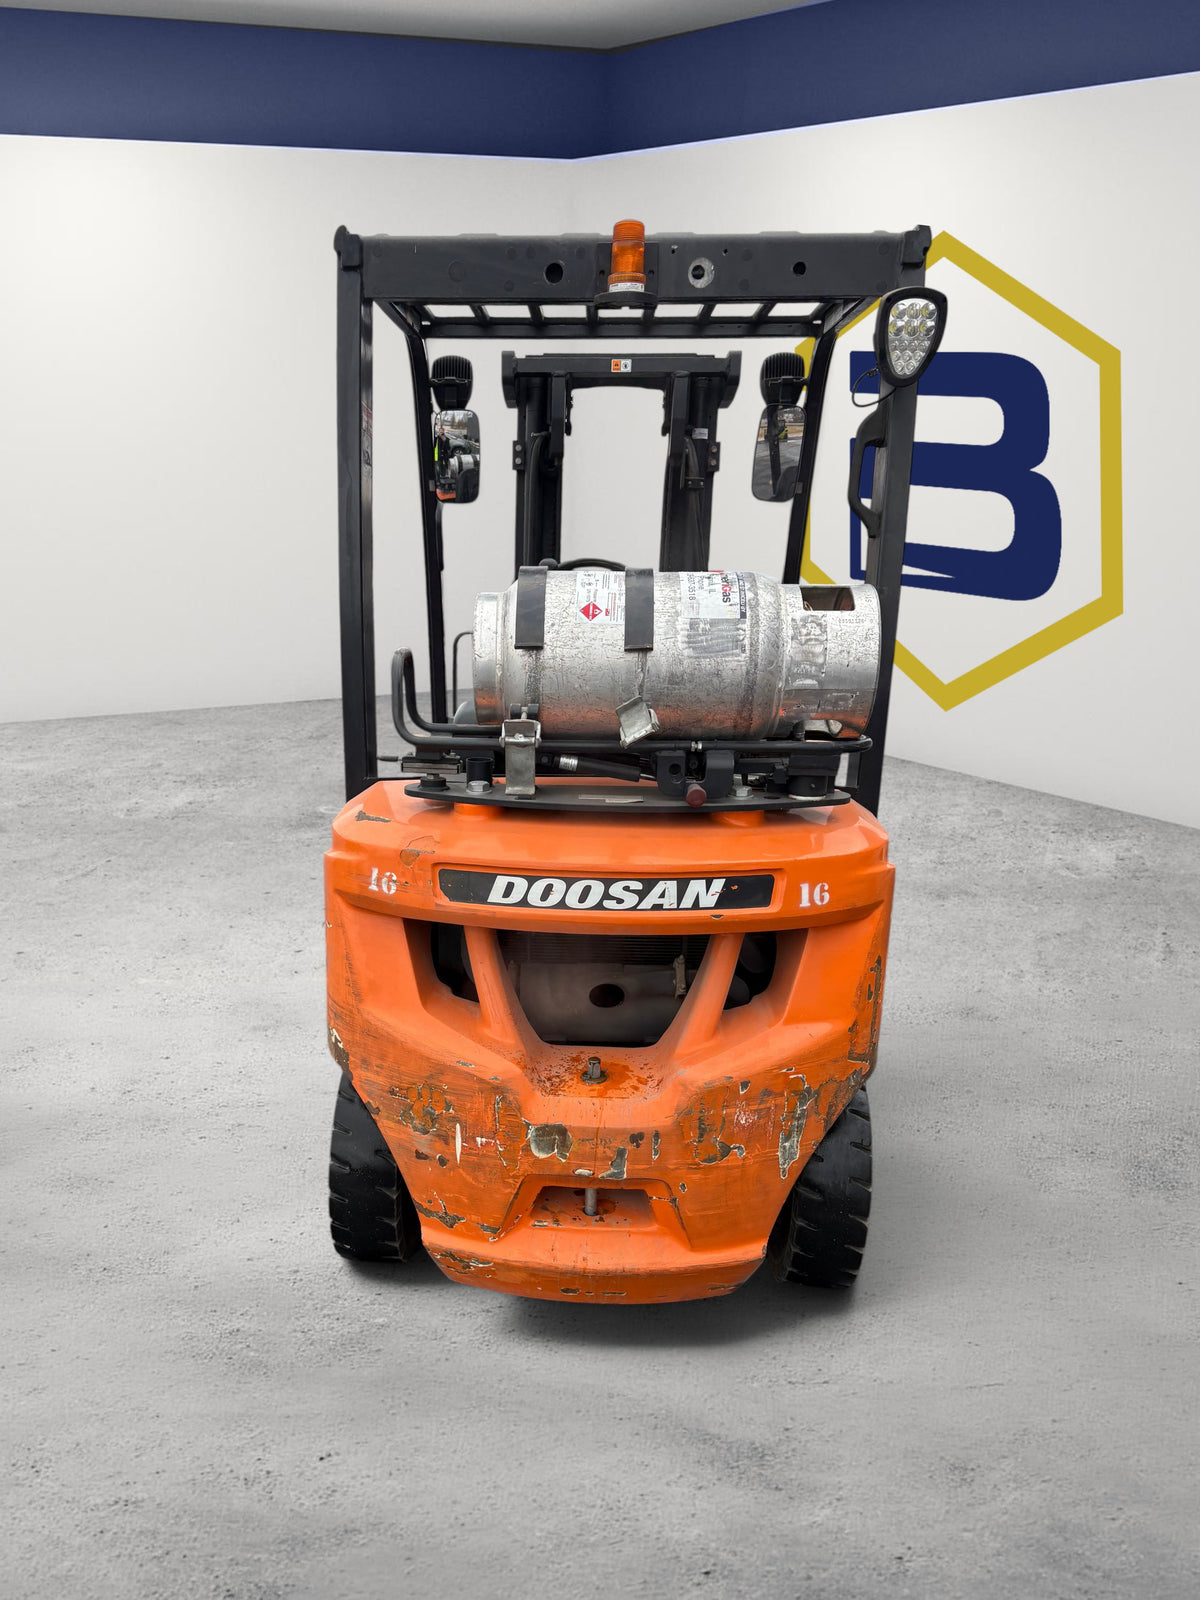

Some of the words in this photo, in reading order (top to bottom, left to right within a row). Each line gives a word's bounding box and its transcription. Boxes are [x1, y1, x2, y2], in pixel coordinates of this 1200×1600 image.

[850, 351, 1062, 601] B
[368, 867, 399, 896] 16
[487, 874, 726, 910] DOOSAN
[799, 882, 831, 908] 16
